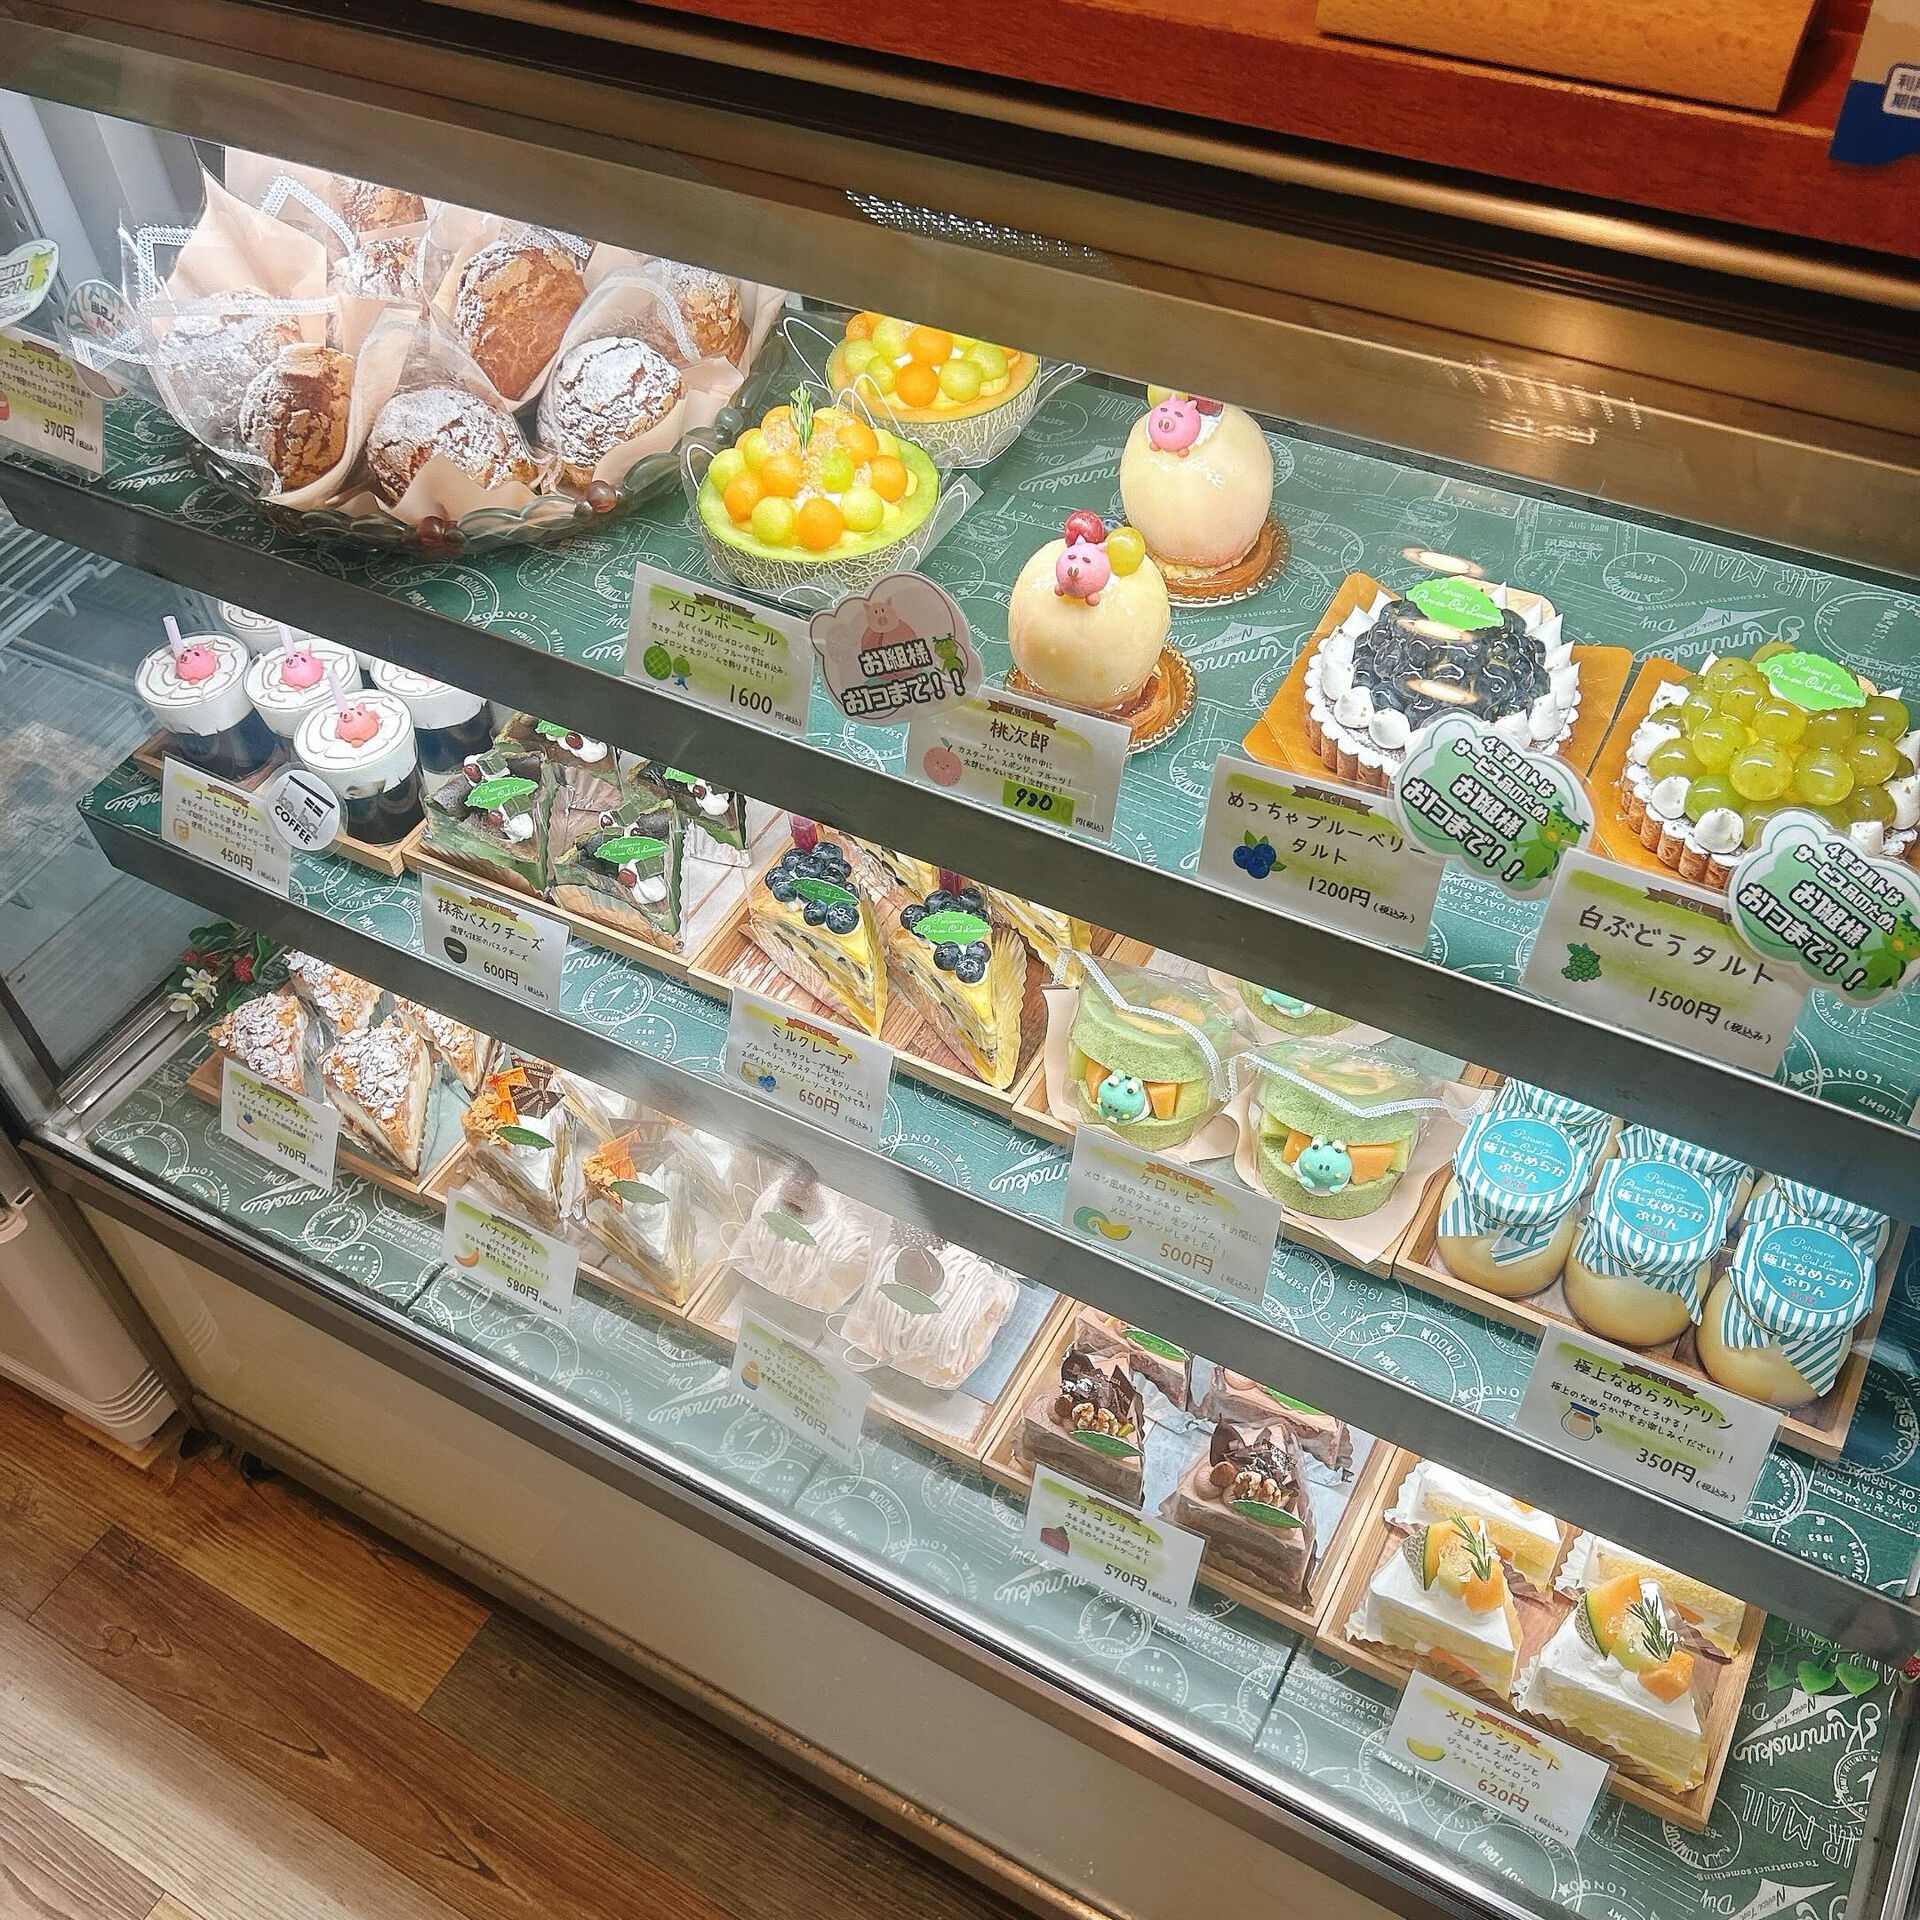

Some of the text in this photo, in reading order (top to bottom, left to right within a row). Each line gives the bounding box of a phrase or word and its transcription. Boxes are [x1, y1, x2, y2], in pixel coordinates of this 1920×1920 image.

[43, 418, 76, 444] 370円
[858, 638, 933, 678] お1組様
[729, 684, 773, 715] 1600
[990, 718, 1050, 753] 桃次郎
[1481, 736, 1556, 798] 4号タルトは
[196, 789, 259, 822] コーヒーゼリー
[1227, 791, 1427, 857] めっちゃブルーベリー
[1451, 773, 1527, 841] お1組様
[274, 805, 312, 845] COFFEE
[220, 847, 253, 871] 450円
[1292, 838, 1349, 865] タルト
[1825, 843, 1904, 908] 4号タルトは
[1308, 876, 1416, 924] 1200円 (税込み)
[1789, 880, 1872, 950] お1組様
[438, 898, 545, 951] 抹茶バスクチーズ
[1580, 905, 1775, 985] 白ぶどうタルト
[483, 961, 519, 986] 600円
[1648, 986, 1772, 1045] 1500円 (税込み)
[772, 1023, 853, 1065] ミルクレープ
[799, 1089, 840, 1117] 650円
[277, 1142, 306, 1165] 570円
[1482, 1140, 1566, 1178] 極上なめらか
[1497, 1161, 1539, 1184] ぷりん
[1141, 1173, 1215, 1208] ケロッピー
[1616, 1188, 1705, 1223] 極上なめらか
[480, 1222, 539, 1255] バナナタルト
[1635, 1209, 1679, 1232] ぷりん
[1160, 1242, 1214, 1275] 500円
[1762, 1252, 1854, 1291] 極上なめらか
[506, 1277, 539, 1302] 580円
[1781, 1274, 1827, 1299] ぷりん
[1573, 1357, 1733, 1430] 極上なめらかプリン
[1602, 1390, 1689, 1432] 口の中でとろける!
[793, 1406, 828, 1436] 570円
[1551, 1380, 1734, 1464] 極上のなめらかさをお楽しみください!!
[1636, 1448, 1736, 1503] 350円 (税込み)
[1067, 1499, 1157, 1545] チョコショート
[1104, 1563, 1147, 1592] 570円
[1446, 1709, 1560, 1771] メロンショート
[1447, 1736, 1540, 1790] ジューシーなメロンの
[1452, 1752, 1525, 1794] ショートケーキ!
[1478, 1779, 1530, 1813] 620円
